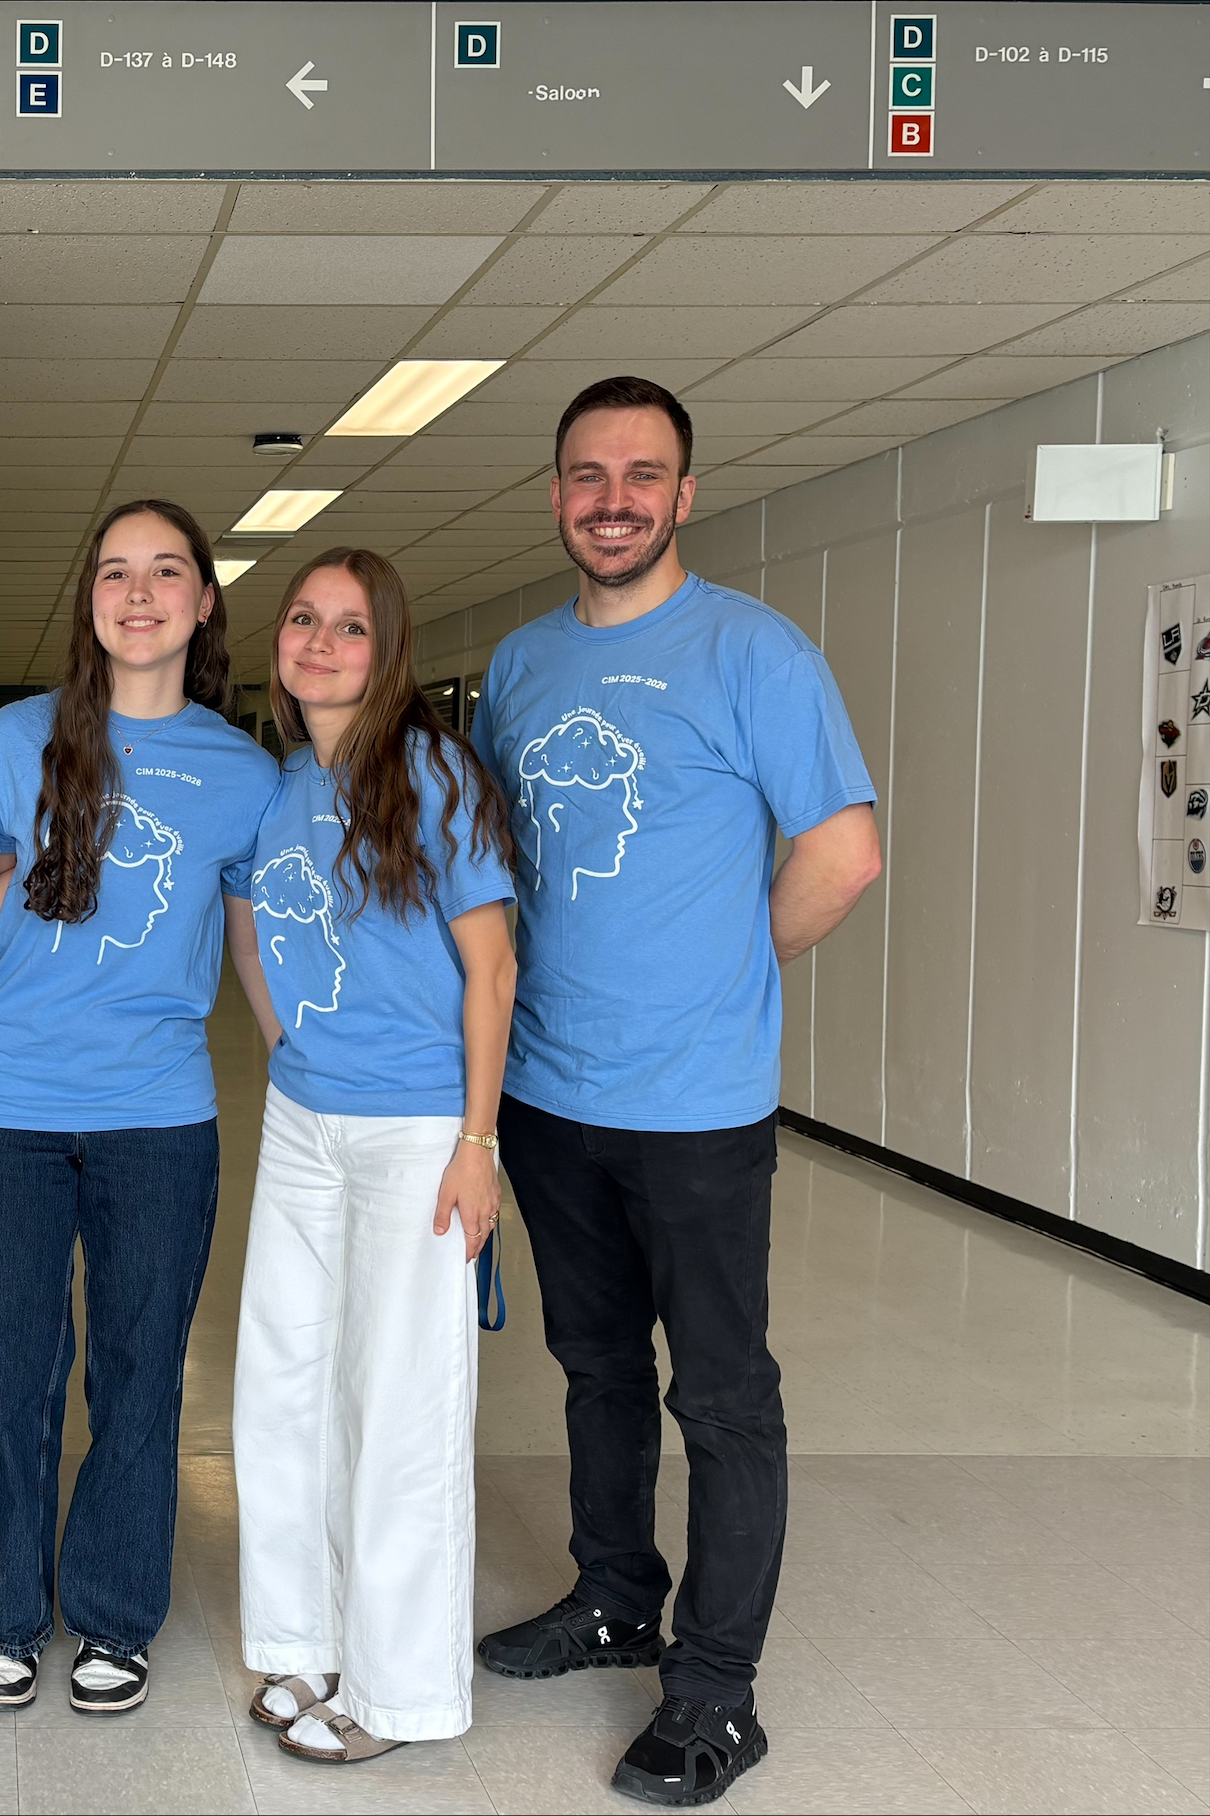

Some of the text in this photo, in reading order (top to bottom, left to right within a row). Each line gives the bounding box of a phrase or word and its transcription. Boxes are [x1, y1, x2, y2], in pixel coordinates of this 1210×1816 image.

[30, 33, 49, 54] D
[467, 34, 487, 57] D
[903, 27, 923, 48] D
[100, 52, 237, 69] D-137 à D-148
[975, 46, 1109, 64] D-102 à D-115
[29, 84, 47, 106] E
[901, 74, 922, 97] C
[902, 124, 920, 145] B
[601, 674, 668, 691] CIM 2025-2026
[561, 709, 576, 722] Une
[577, 705, 603, 723] journée
[601, 719, 617, 732] pour
[135, 767, 203, 787] CIM 2025-2026
[137, 806, 156, 819] pour
